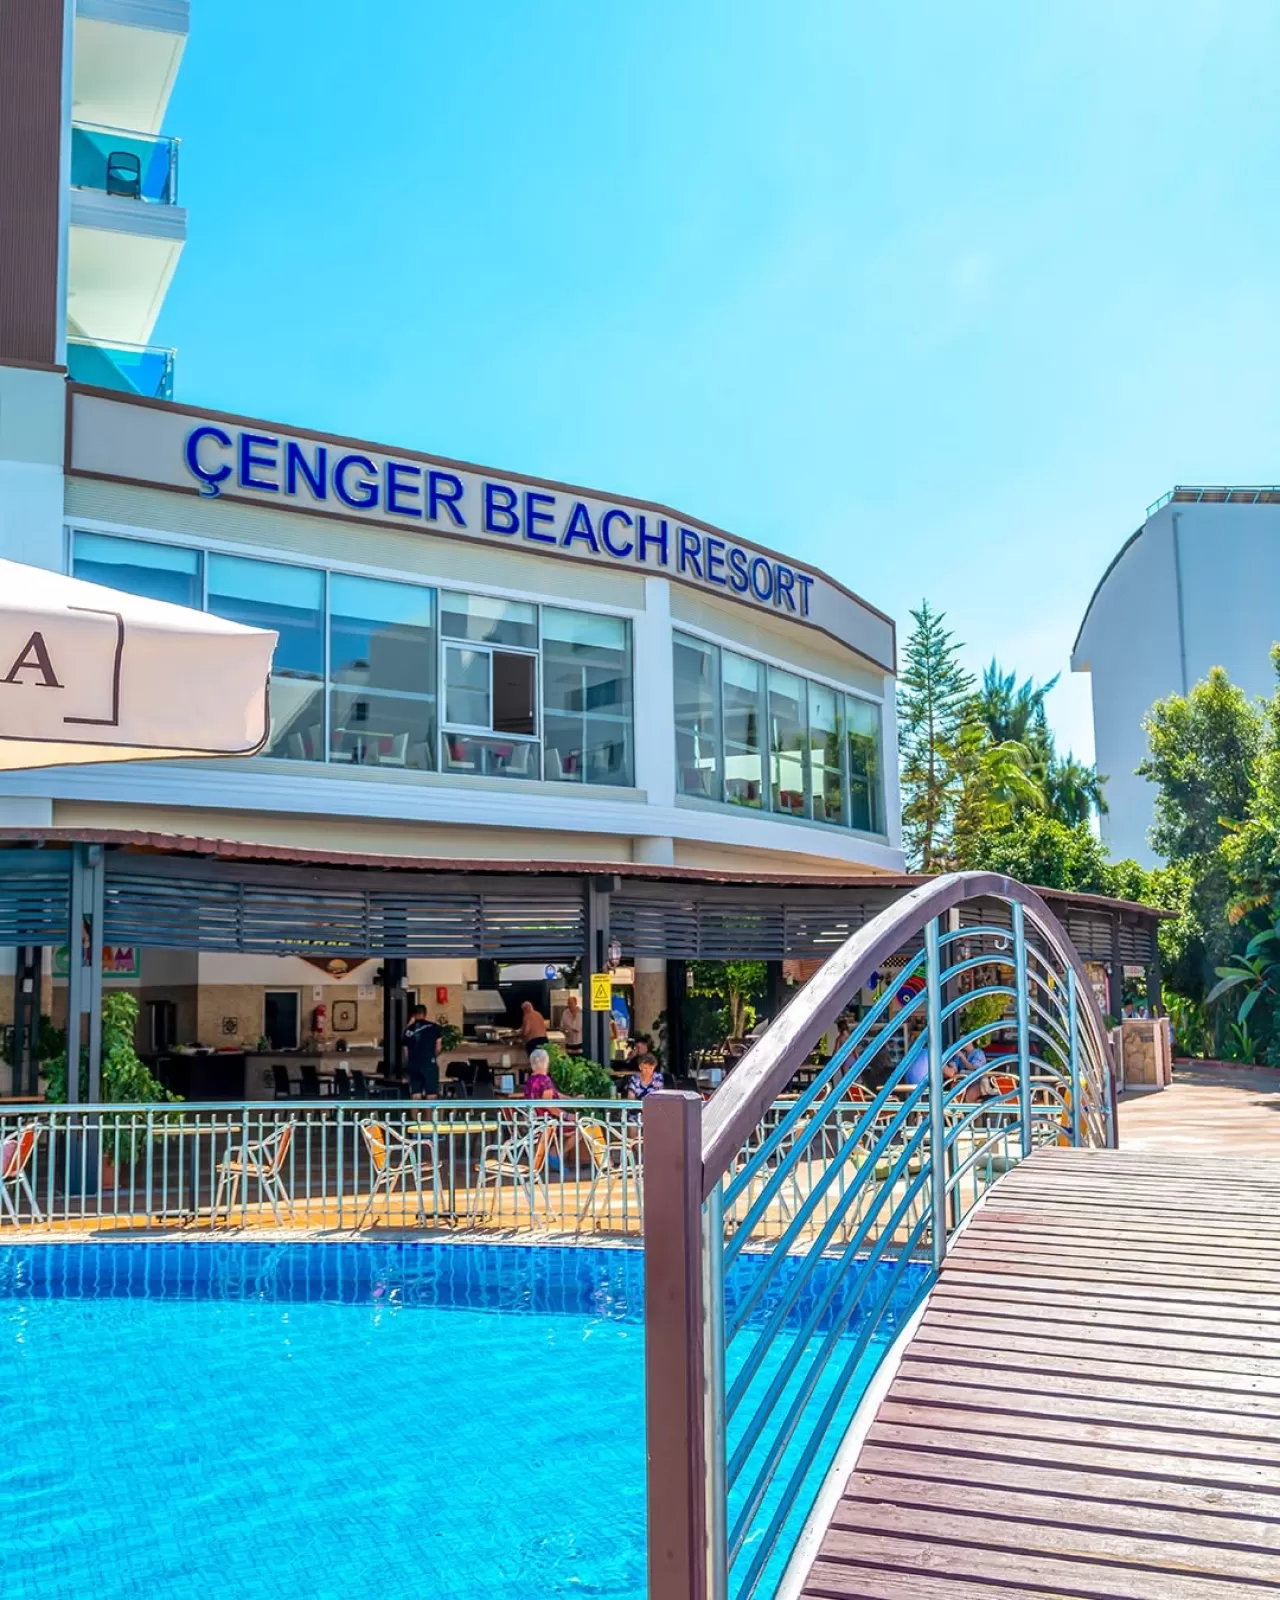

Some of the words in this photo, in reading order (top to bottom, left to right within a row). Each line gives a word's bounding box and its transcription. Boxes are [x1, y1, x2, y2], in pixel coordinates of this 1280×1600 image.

[184, 426, 467, 527] ÇENGER
[482, 481, 668, 565] BEACH
[677, 525, 814, 616] RESORT
